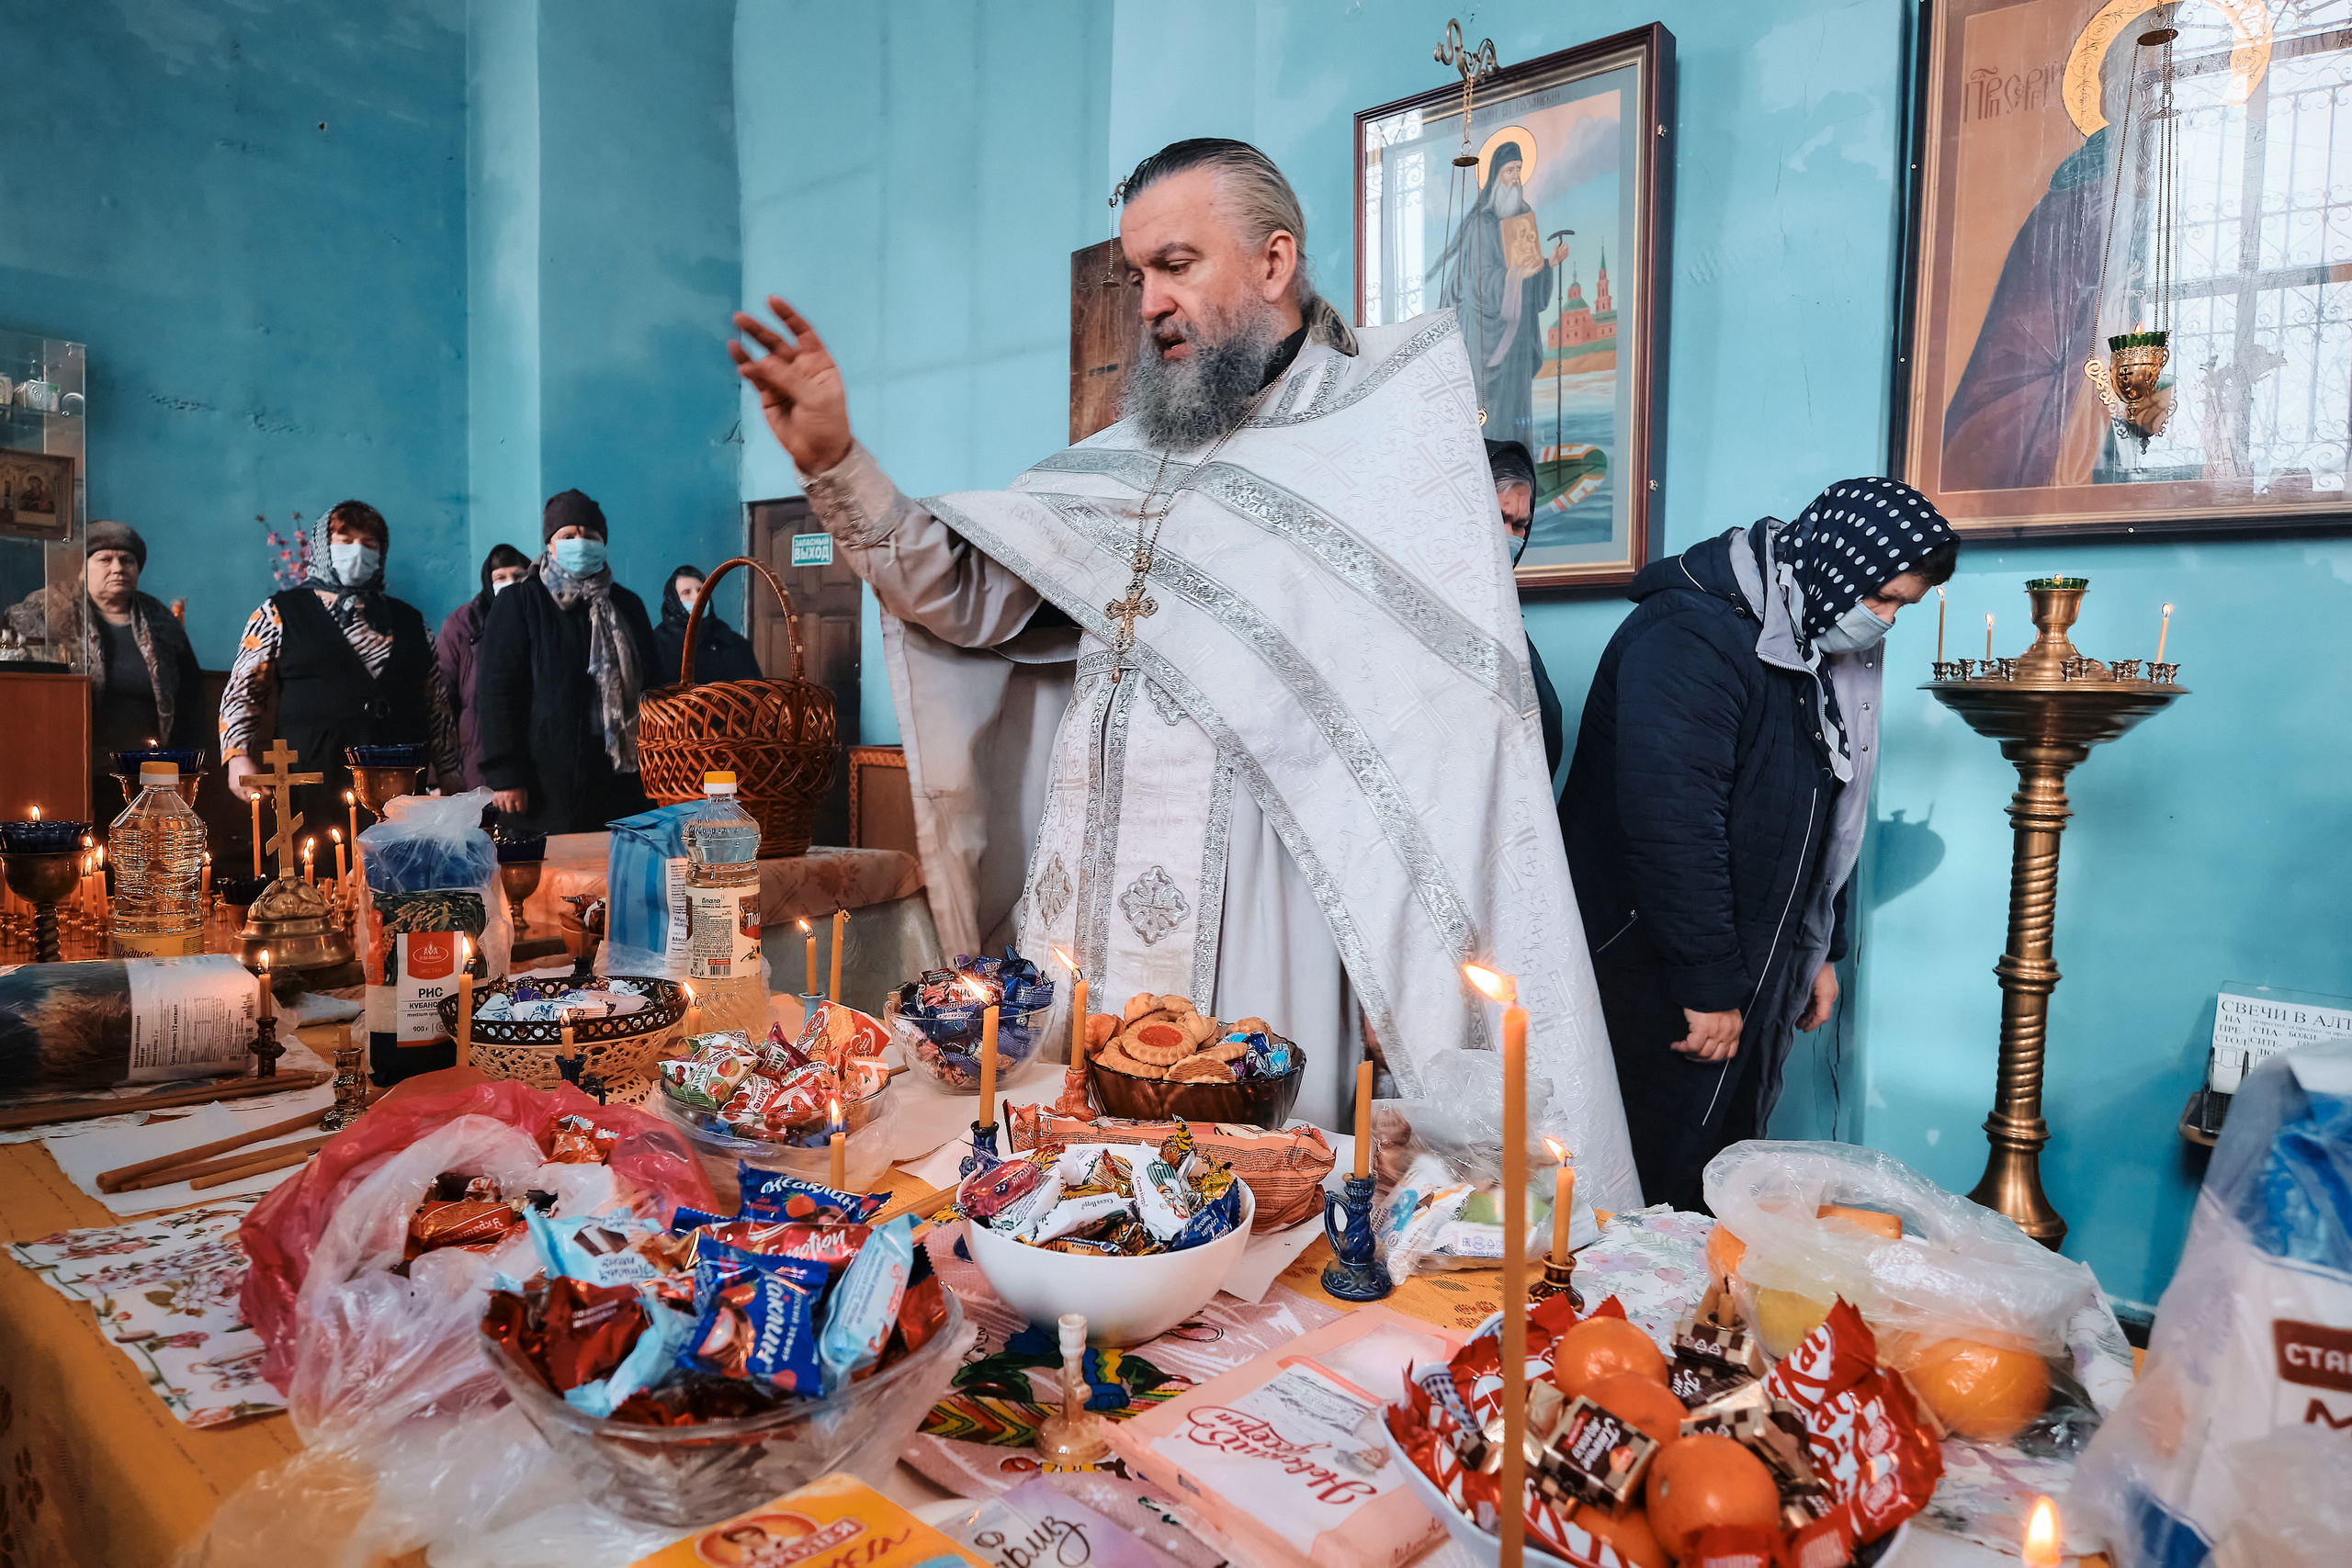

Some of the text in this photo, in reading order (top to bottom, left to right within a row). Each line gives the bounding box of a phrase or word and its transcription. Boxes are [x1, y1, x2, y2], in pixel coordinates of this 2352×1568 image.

[795, 536, 830, 547] ЗАПАСНЫЙ
[794, 546, 830, 561] ВЫХОД
[418, 987, 444, 998] РИС
[409, 1000, 440, 1010] КУБАНС
[2221, 1000, 2287, 1021] СВЕЧИ
[2294, 1011, 2306, 1023] В
[2224, 1014, 2242, 1024] НА
[2214, 1034, 2247, 1046] СТОЛ
[705, 1051, 731, 1066] Желе
[756, 1274, 786, 1366] аклин
